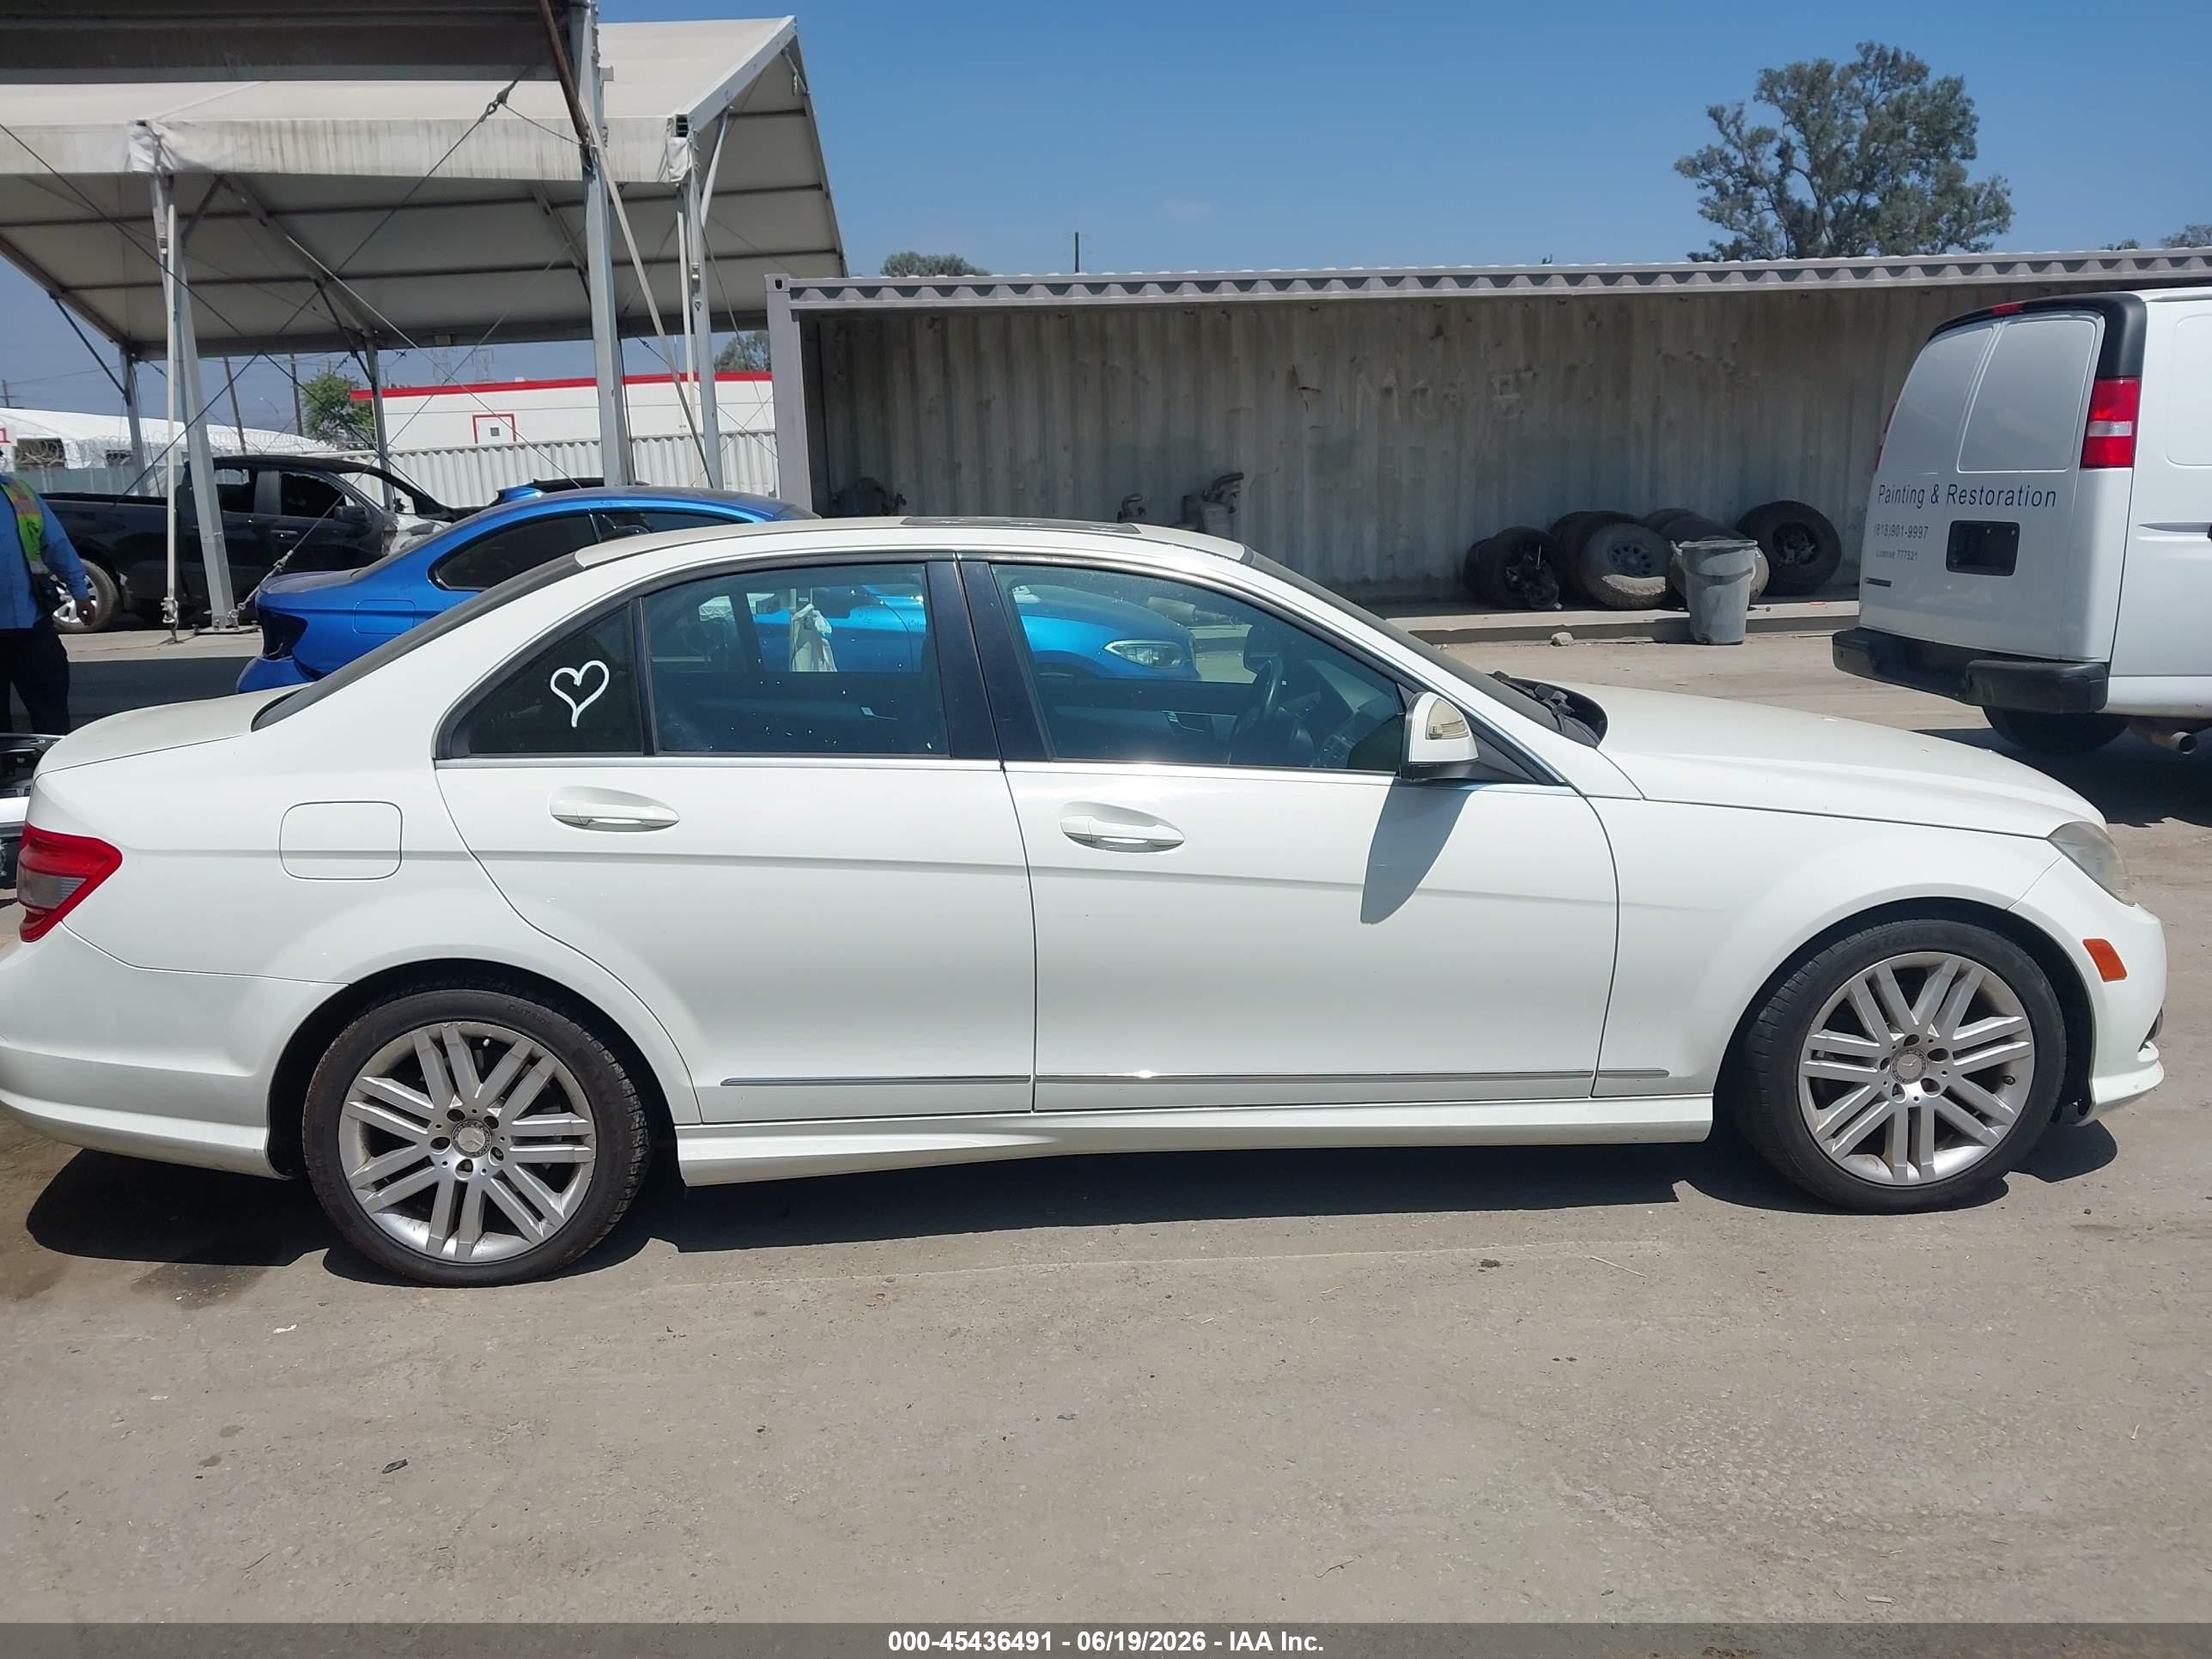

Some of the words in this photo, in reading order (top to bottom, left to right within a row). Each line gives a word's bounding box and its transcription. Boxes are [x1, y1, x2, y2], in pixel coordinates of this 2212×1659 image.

[1878, 483, 1925, 508] Painting
[1930, 483, 1939, 504] &
[1946, 483, 2057, 507] Restoration
